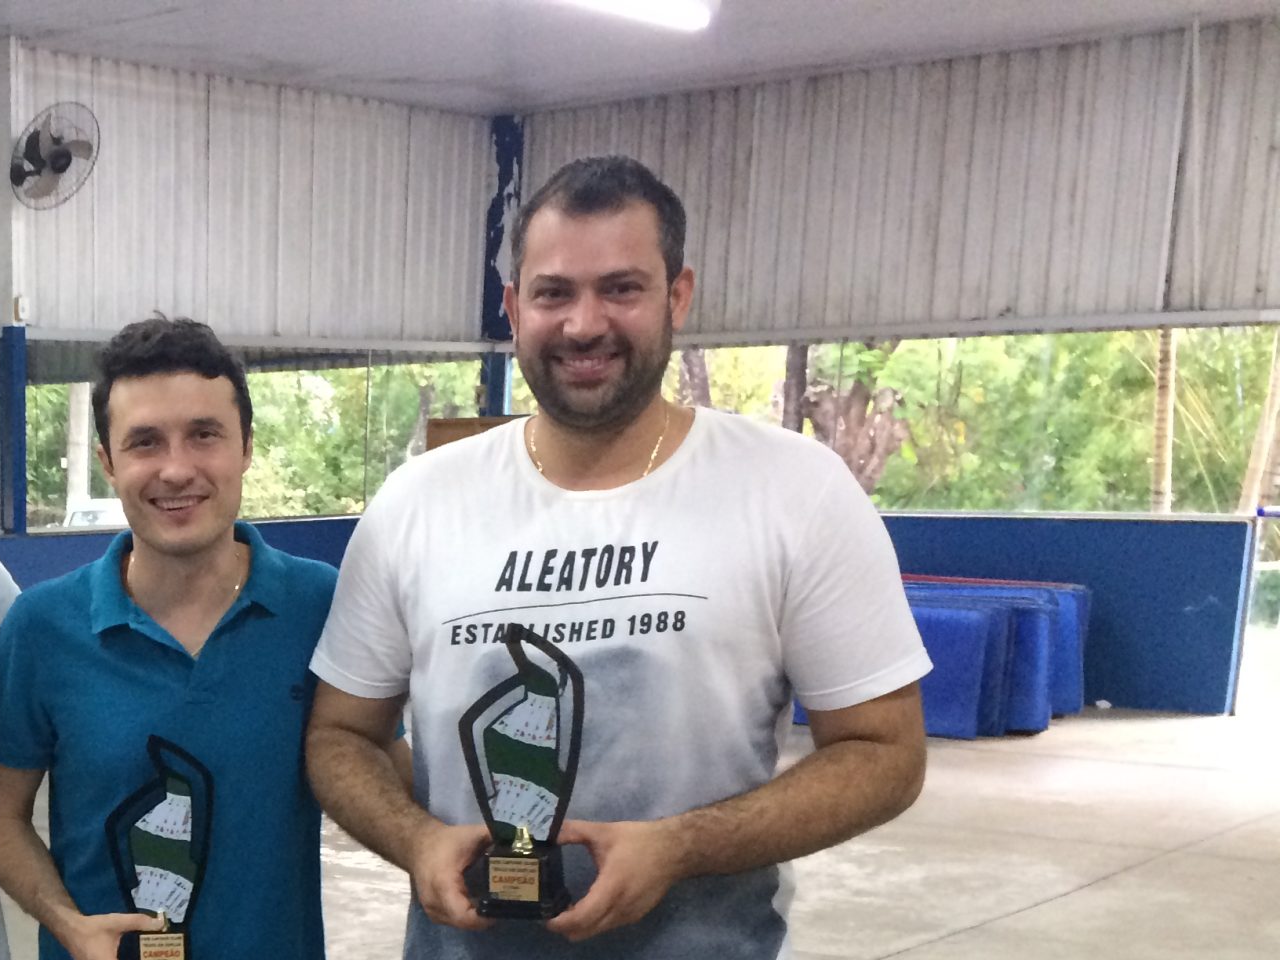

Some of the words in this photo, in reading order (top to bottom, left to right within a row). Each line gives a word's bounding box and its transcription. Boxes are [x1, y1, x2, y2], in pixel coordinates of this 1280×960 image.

[494, 540, 659, 592] ALEATORY
[450, 618, 616, 645] ESTAISHED
[627, 610, 686, 636] 1988
